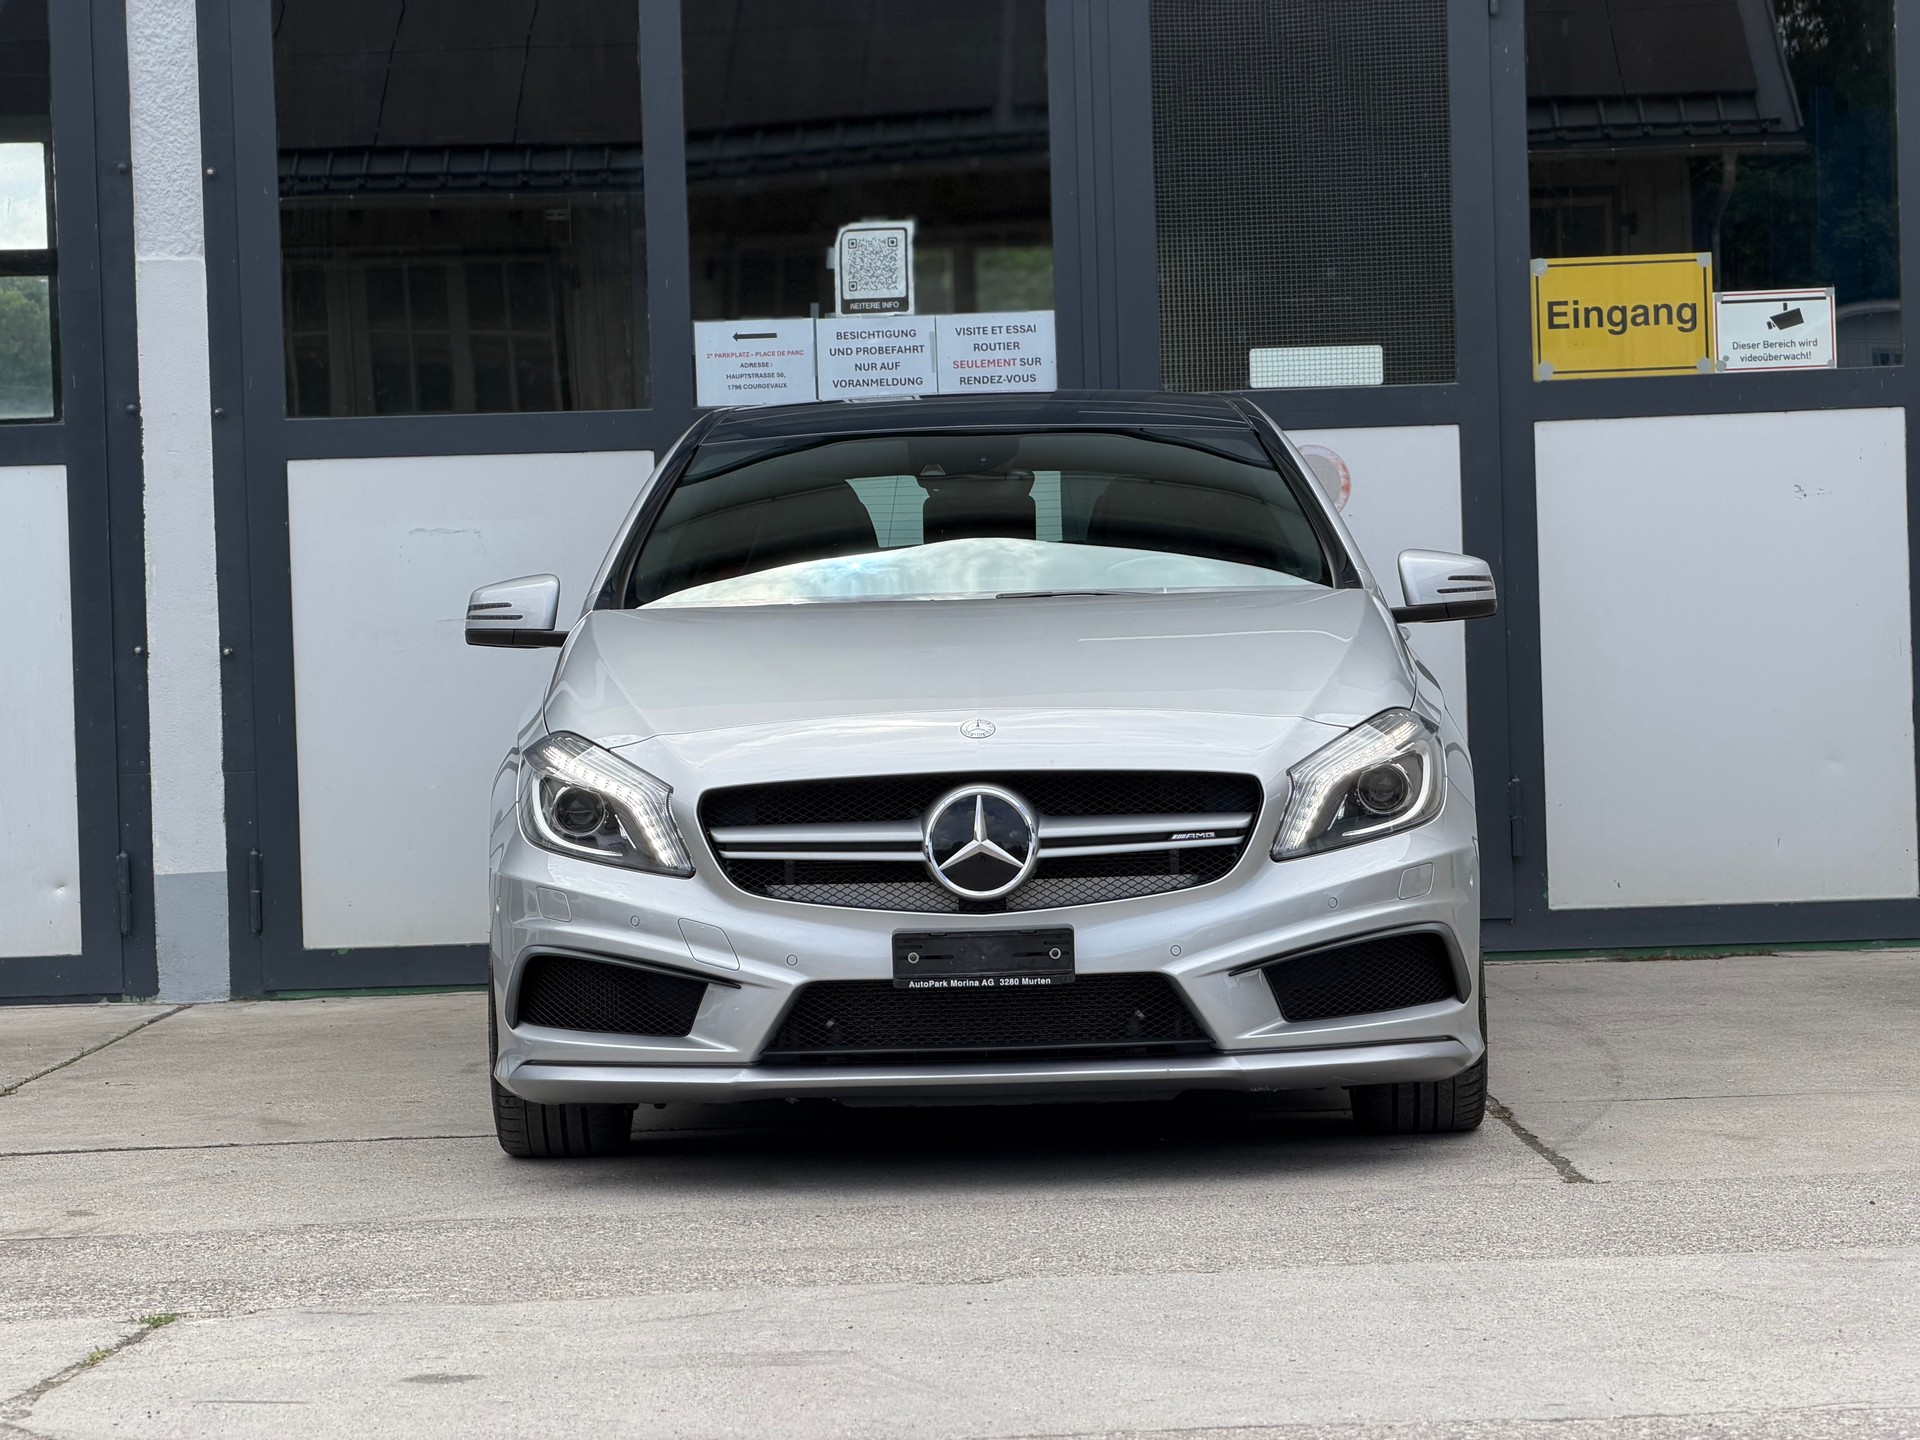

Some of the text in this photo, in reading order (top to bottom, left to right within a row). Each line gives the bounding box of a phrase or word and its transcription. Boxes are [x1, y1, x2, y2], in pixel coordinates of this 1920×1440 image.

[882, 301, 900, 309] INFO
[1547, 300, 1697, 336] Eingang
[836, 329, 917, 340] BESICHTIGUNG
[955, 324, 1037, 336] VISITE ET ESSAI
[973, 341, 1020, 352] ROUTIER
[1732, 338, 1818, 351] Dieser Bereich wird
[714, 351, 750, 359] PARKPLATZ
[829, 345, 925, 357] UND PROBEFAHRT
[1739, 351, 1812, 362] videoüberwacht!
[854, 361, 901, 372] NUR AUF
[952, 357, 1042, 369] SEULEMENT SUR
[726, 372, 775, 380] HAUPTSTRASSE
[959, 374, 1037, 385] RENDEZ-VOUS
[832, 377, 924, 388] VORANMELDUNG
[909, 977, 1051, 988] AutoPark Morina AG 3280 Murten
